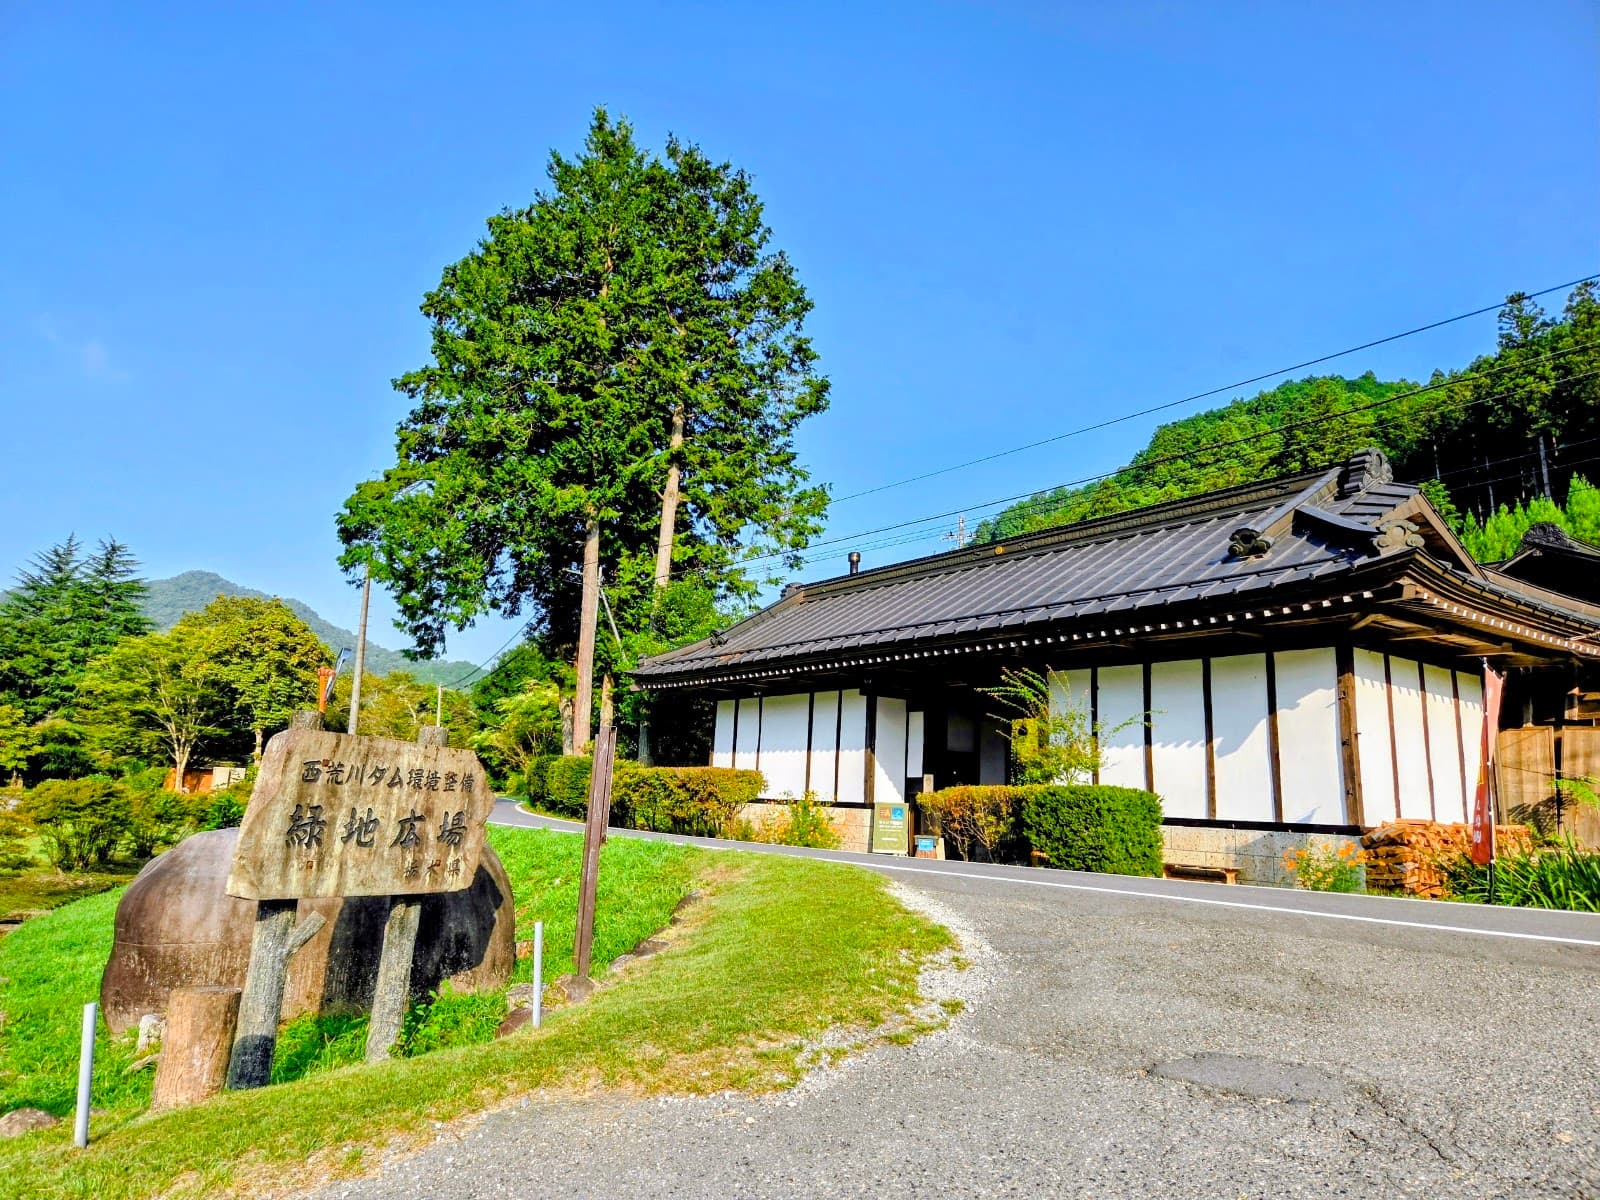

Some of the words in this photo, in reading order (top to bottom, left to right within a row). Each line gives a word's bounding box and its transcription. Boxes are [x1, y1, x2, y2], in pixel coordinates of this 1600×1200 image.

[302, 760, 475, 793] 西荒川ダム環境整備
[285, 804, 468, 849] 緑地広場
